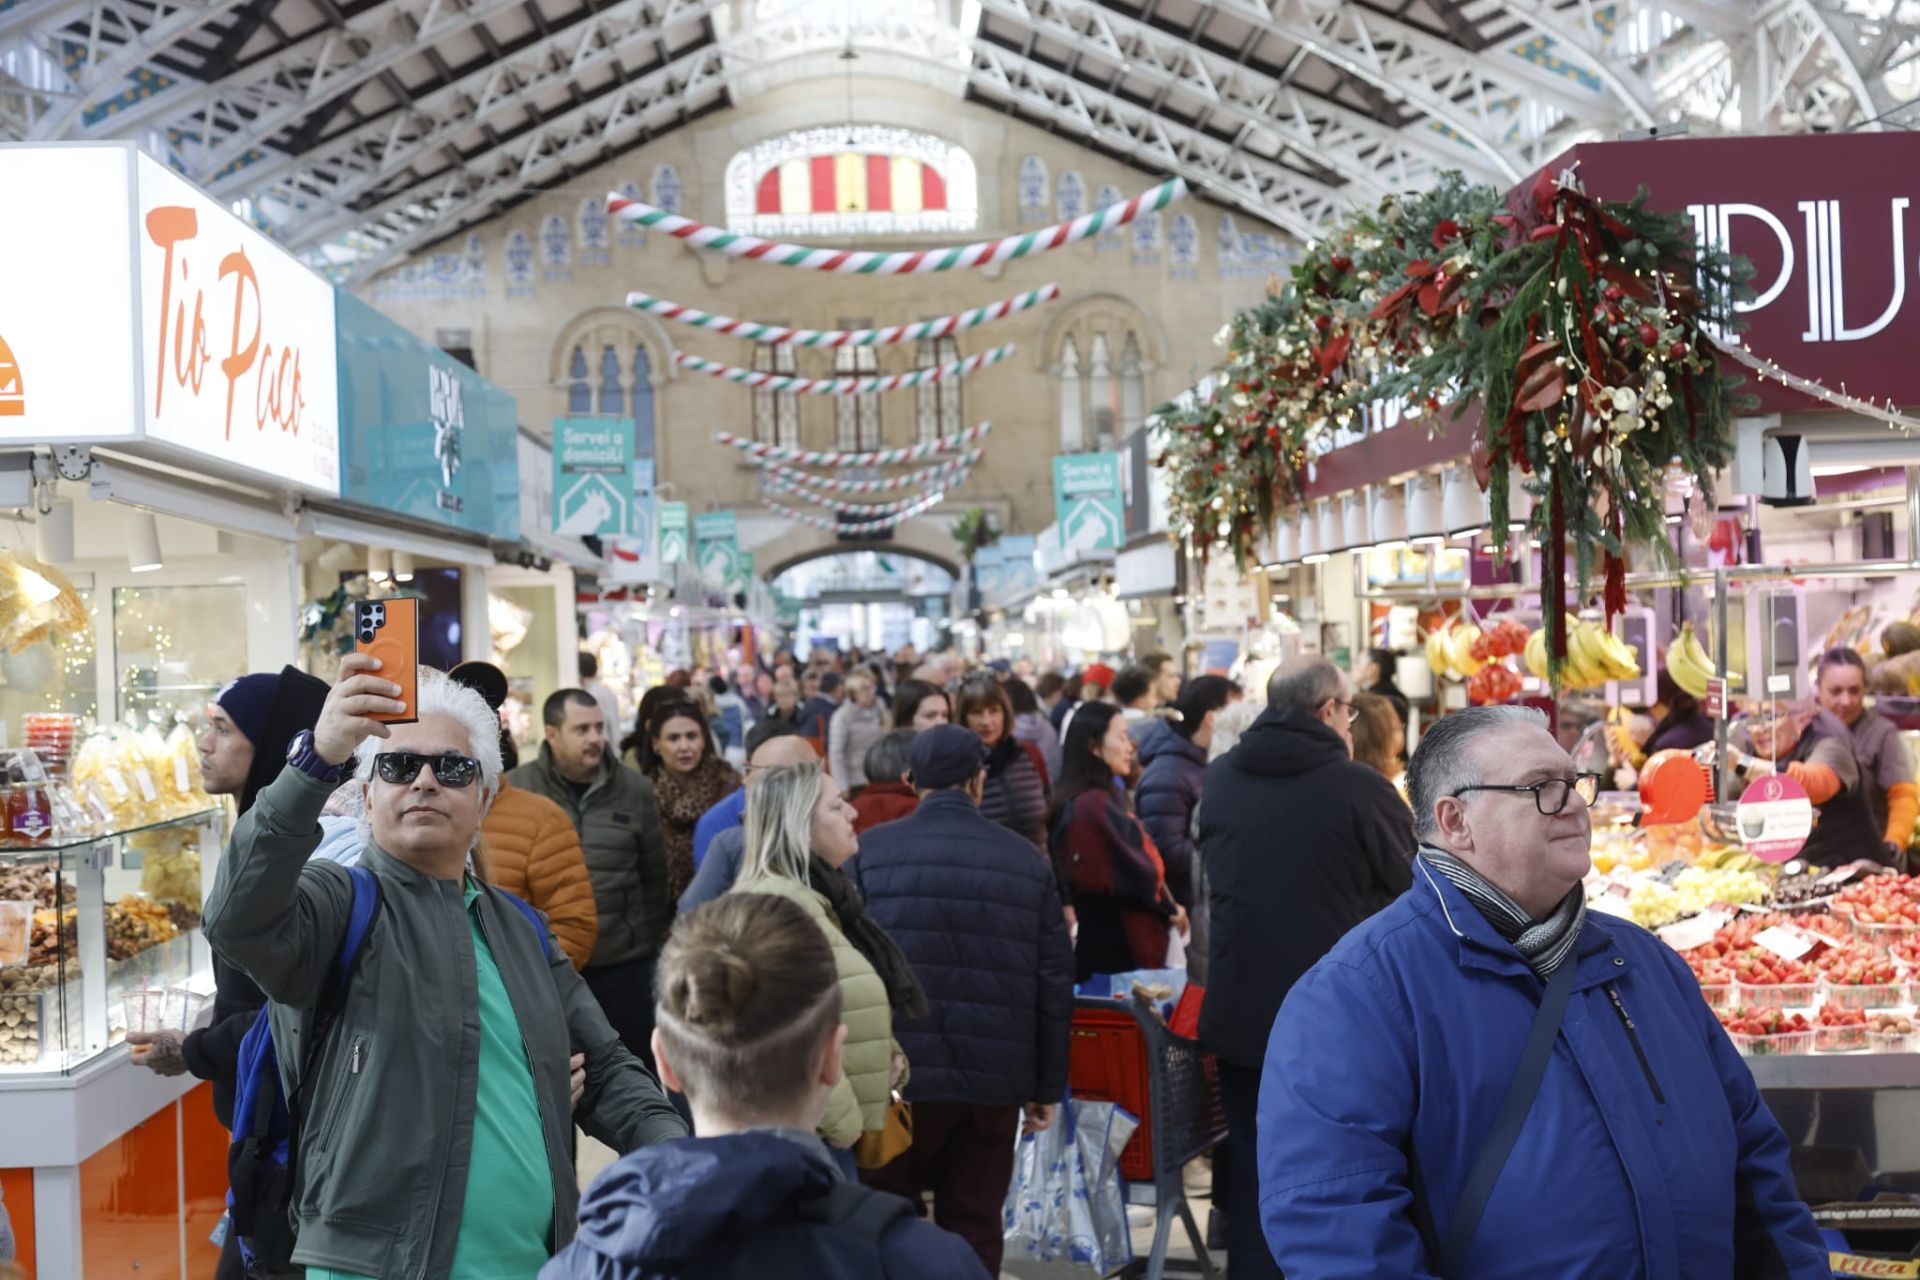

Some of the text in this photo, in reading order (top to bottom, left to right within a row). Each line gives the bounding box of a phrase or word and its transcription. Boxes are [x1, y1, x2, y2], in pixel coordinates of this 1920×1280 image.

[218, 243, 305, 438] Paco
[1687, 197, 1920, 344] PU
[563, 427, 610, 445] Servei
